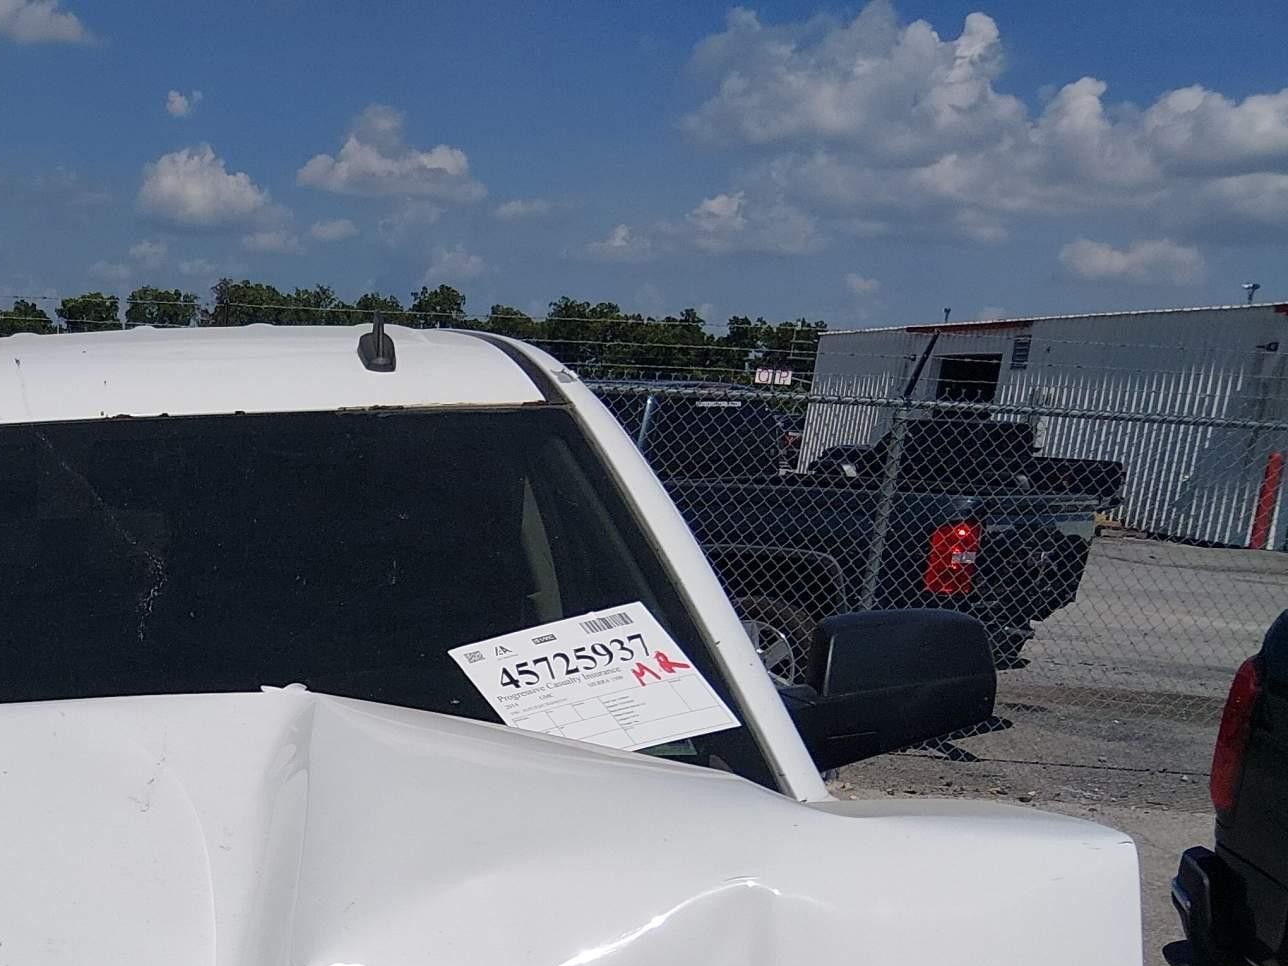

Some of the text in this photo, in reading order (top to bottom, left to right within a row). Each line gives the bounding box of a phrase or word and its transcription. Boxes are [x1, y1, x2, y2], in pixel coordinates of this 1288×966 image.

[500, 633, 650, 689] 45725937
[497, 667, 622, 702] Progressive Casualty Insurance
